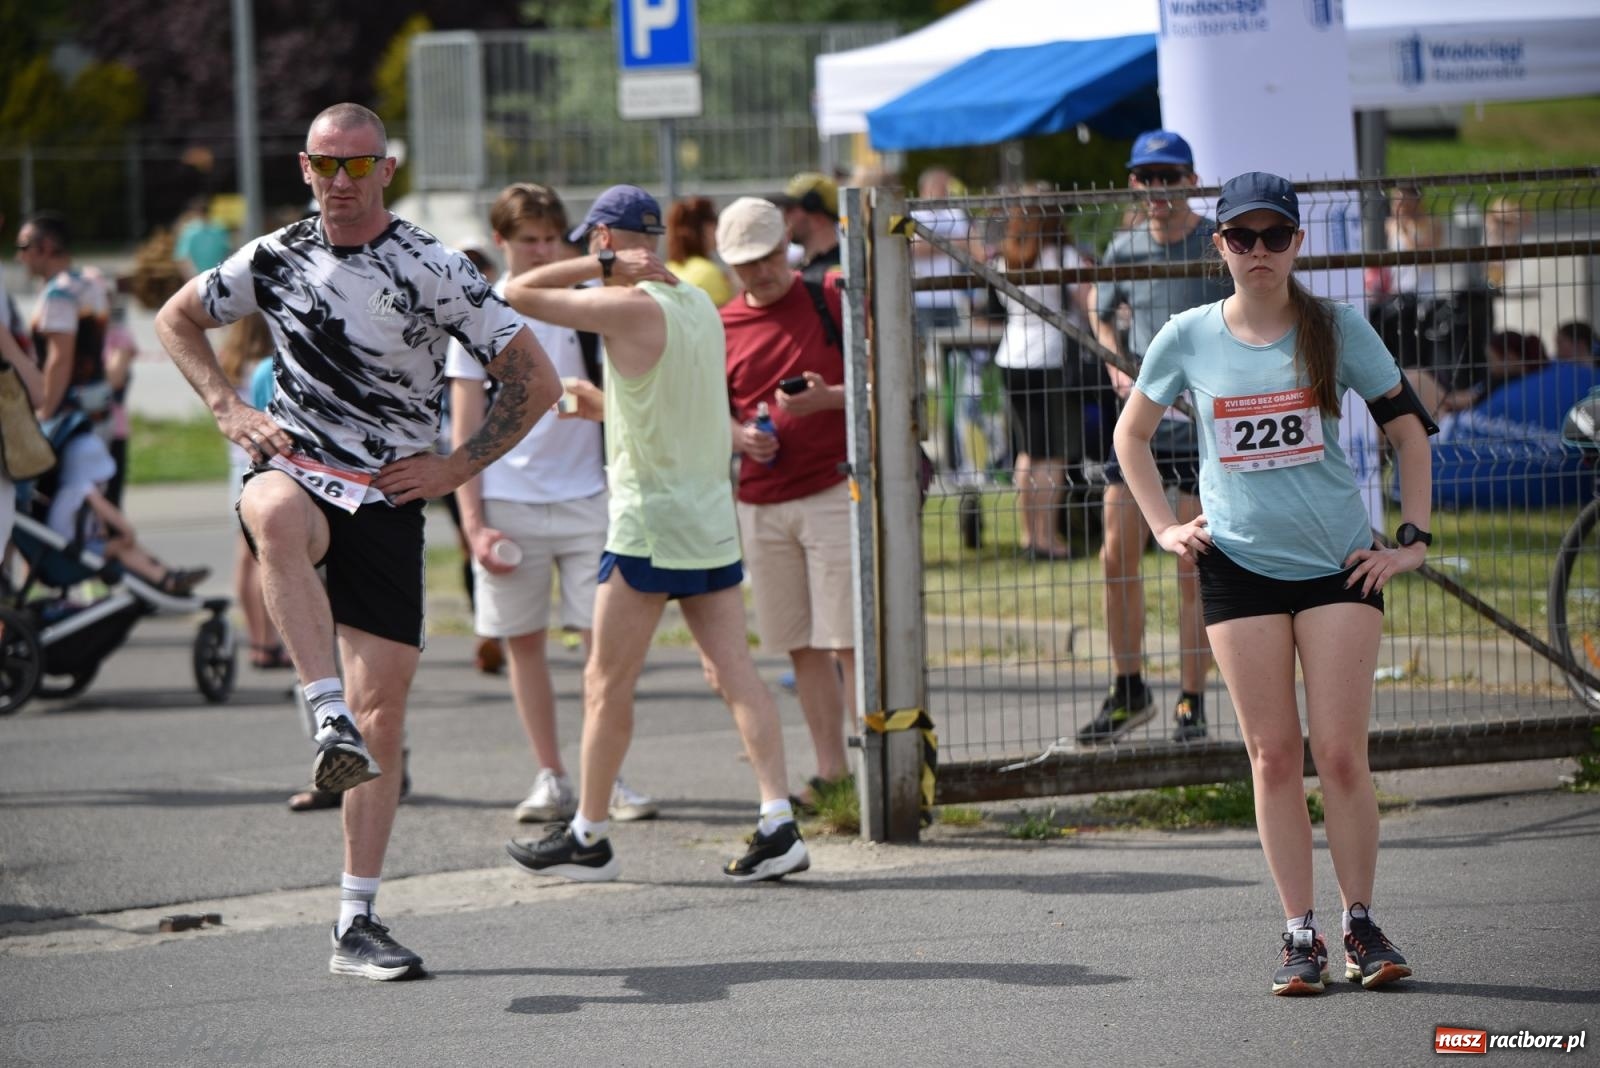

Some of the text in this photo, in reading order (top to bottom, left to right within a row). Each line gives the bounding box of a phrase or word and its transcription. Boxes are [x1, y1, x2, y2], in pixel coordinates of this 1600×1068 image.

[632, 0, 679, 59] P
[1225, 400, 1238, 408] XVI
[1239, 398, 1257, 407] BIEG
[1257, 396, 1273, 405] BEZ
[1234, 415, 1305, 451] 228
